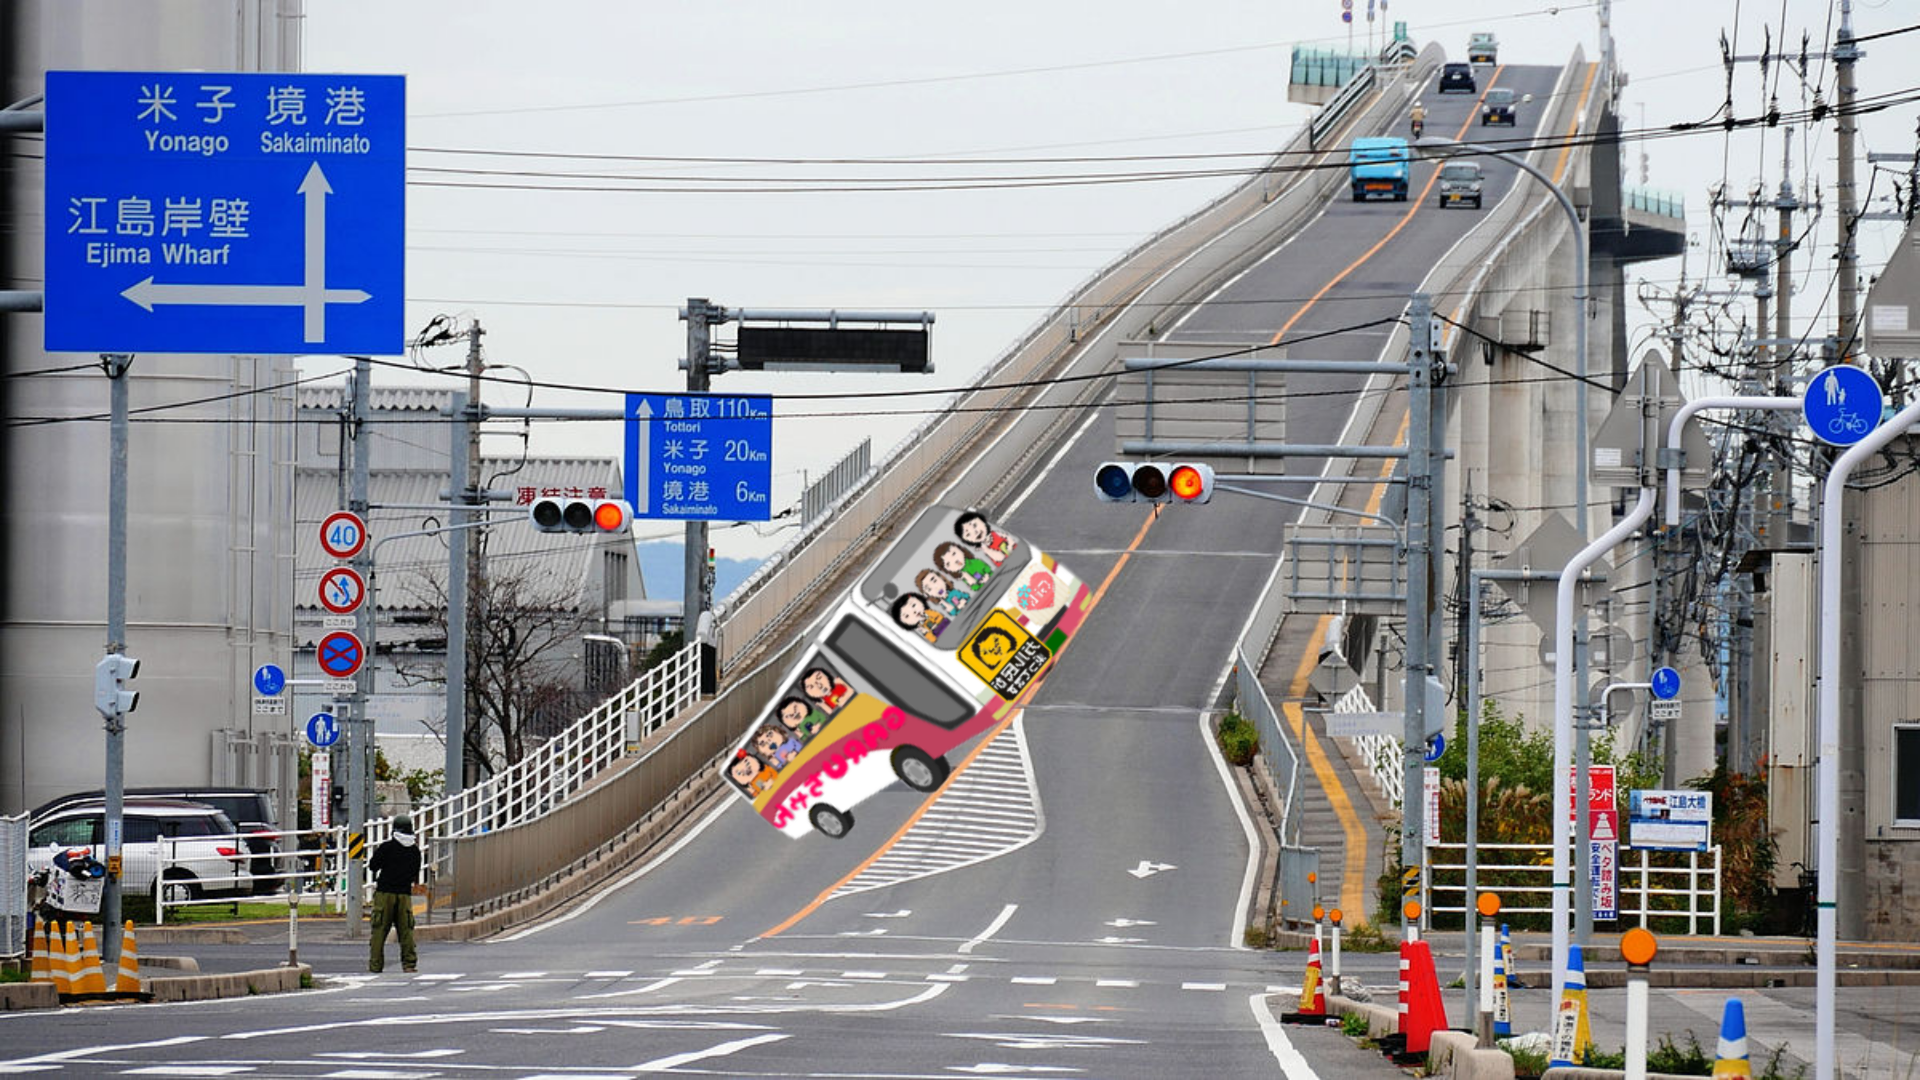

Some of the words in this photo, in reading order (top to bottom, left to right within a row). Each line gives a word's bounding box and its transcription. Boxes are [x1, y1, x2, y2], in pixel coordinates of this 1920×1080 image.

[137, 84, 236, 124] 米子
[265, 85, 366, 126] 境港
[144, 130, 229, 156] Yonago
[260, 131, 371, 154] Sakaiminato
[67, 195, 250, 238] 江島岸壁
[87, 242, 151, 267] Ejima
[161, 243, 230, 265] Wharf
[663, 398, 710, 418] 鳥取
[664, 420, 701, 433] Tottori
[663, 439, 709, 460] 米子
[663, 462, 707, 476] Yonago
[662, 480, 709, 502] 境港
[662, 502, 718, 515] Sakaiminato
[330, 525, 356, 546] 40
